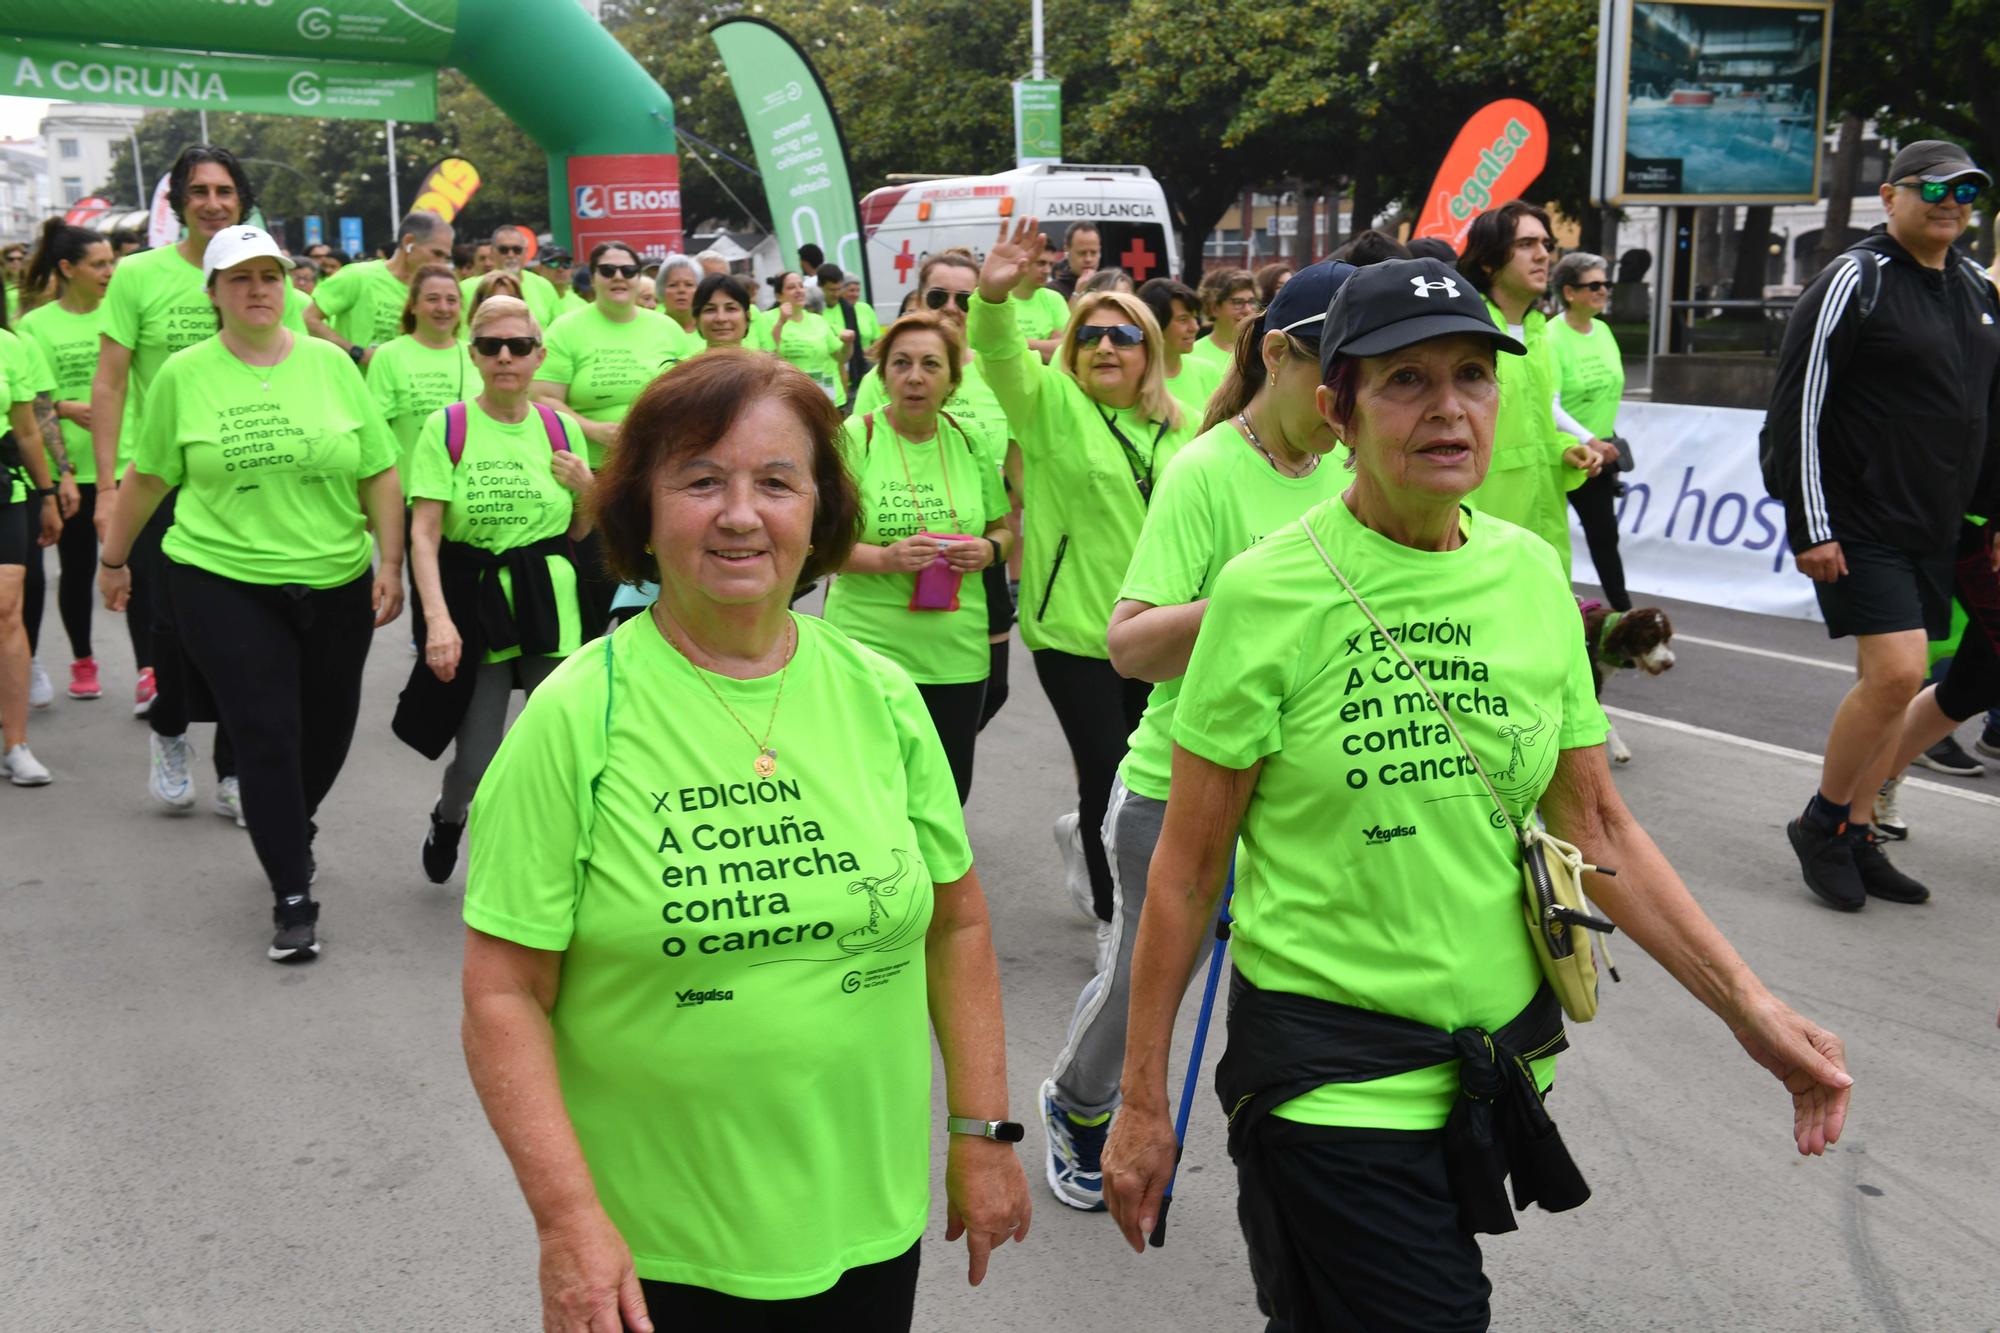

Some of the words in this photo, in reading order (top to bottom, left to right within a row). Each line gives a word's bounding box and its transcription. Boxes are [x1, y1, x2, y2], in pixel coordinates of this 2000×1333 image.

[15, 56, 44, 88] A
[51, 61, 229, 101] CORUÑA
[1047, 203, 1155, 217] AMBULANCIA
[217, 411, 226, 419] X
[228, 402, 281, 416] EDICIÓN
[220, 423, 230, 433] A
[233, 416, 290, 430] Coruña
[221, 433, 240, 444] en
[244, 427, 305, 441] marcha
[222, 442, 275, 458] contra
[225, 462, 236, 472] o
[239, 454, 294, 469] cancro
[476, 460, 524, 471] EDICIÓN
[467, 476, 476, 486] A
[480, 475, 530, 486] Coruña
[467, 491, 484, 500] en
[489, 488, 542, 499] marcha
[878, 496, 888, 507] A
[892, 496, 944, 508] Coruña
[467, 501, 514, 514] contra
[878, 512, 897, 522] en
[902, 509, 957, 521] marcha
[469, 518, 478, 526] o
[481, 516, 529, 525] cancro
[1345, 634, 1363, 656] X
[1343, 667, 1365, 696] A
[1371, 655, 1489, 683] Coruña
[1339, 697, 1383, 723] en
[1394, 687, 1510, 717] marcha
[1342, 720, 1451, 756] contra
[1346, 768, 1368, 789] o
[651, 791, 672, 813] X
[679, 777, 802, 812] EDICIÓN
[657, 826, 684, 854] A
[692, 815, 825, 851] Coruña
[1362, 824, 1417, 842] Vegalsa
[662, 863, 708, 888] en
[719, 847, 861, 884] marcha
[662, 889, 790, 924] contra
[662, 935, 686, 957] o
[698, 920, 835, 955] cancro
[675, 988, 734, 1004] Vegalsa
